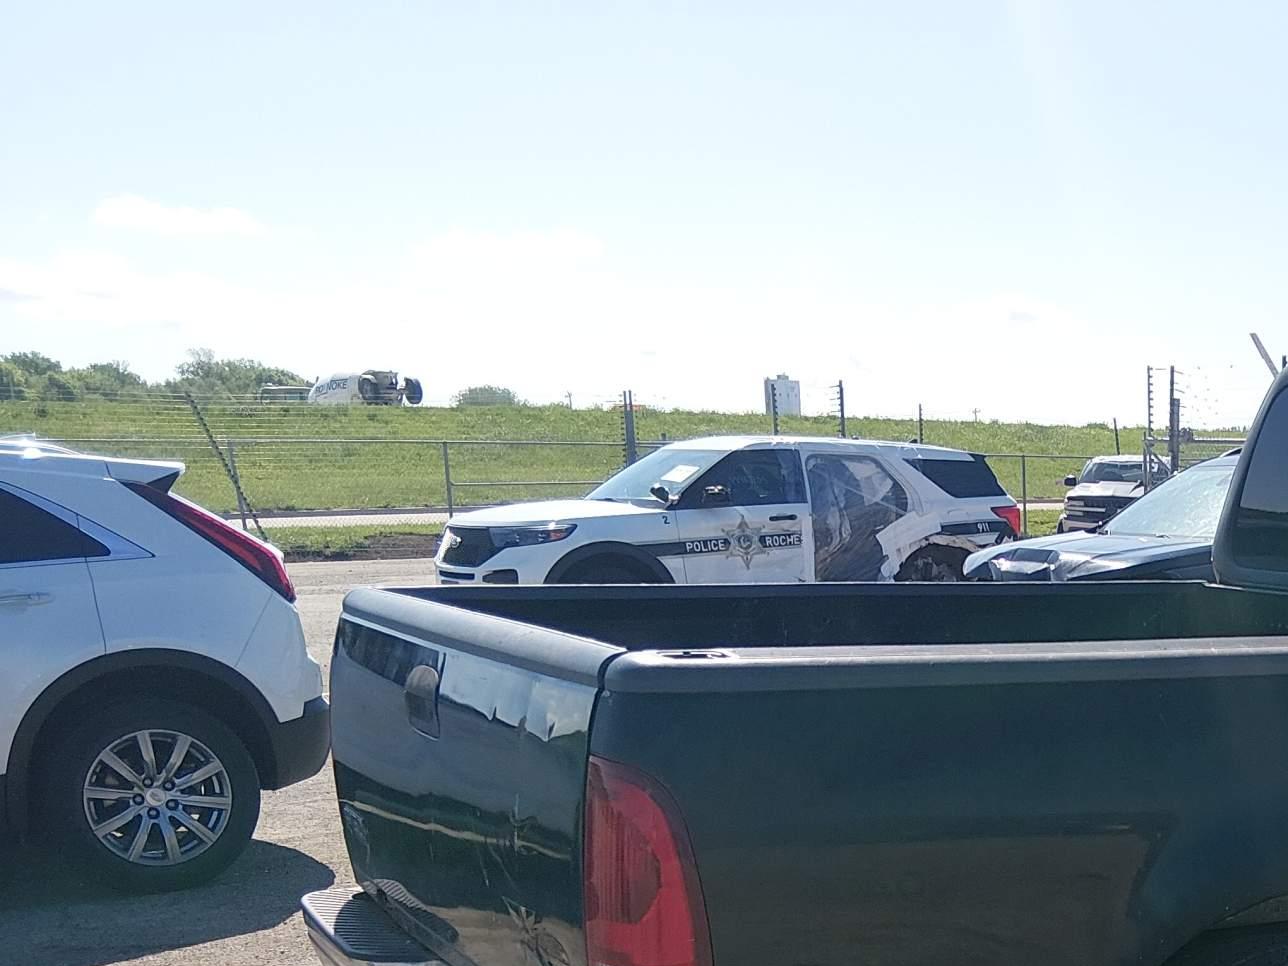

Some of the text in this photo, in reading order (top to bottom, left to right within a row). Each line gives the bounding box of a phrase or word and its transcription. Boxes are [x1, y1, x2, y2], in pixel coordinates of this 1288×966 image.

[662, 515, 670, 524] 2
[977, 522, 990, 532] 911
[685, 539, 726, 553] POLICE
